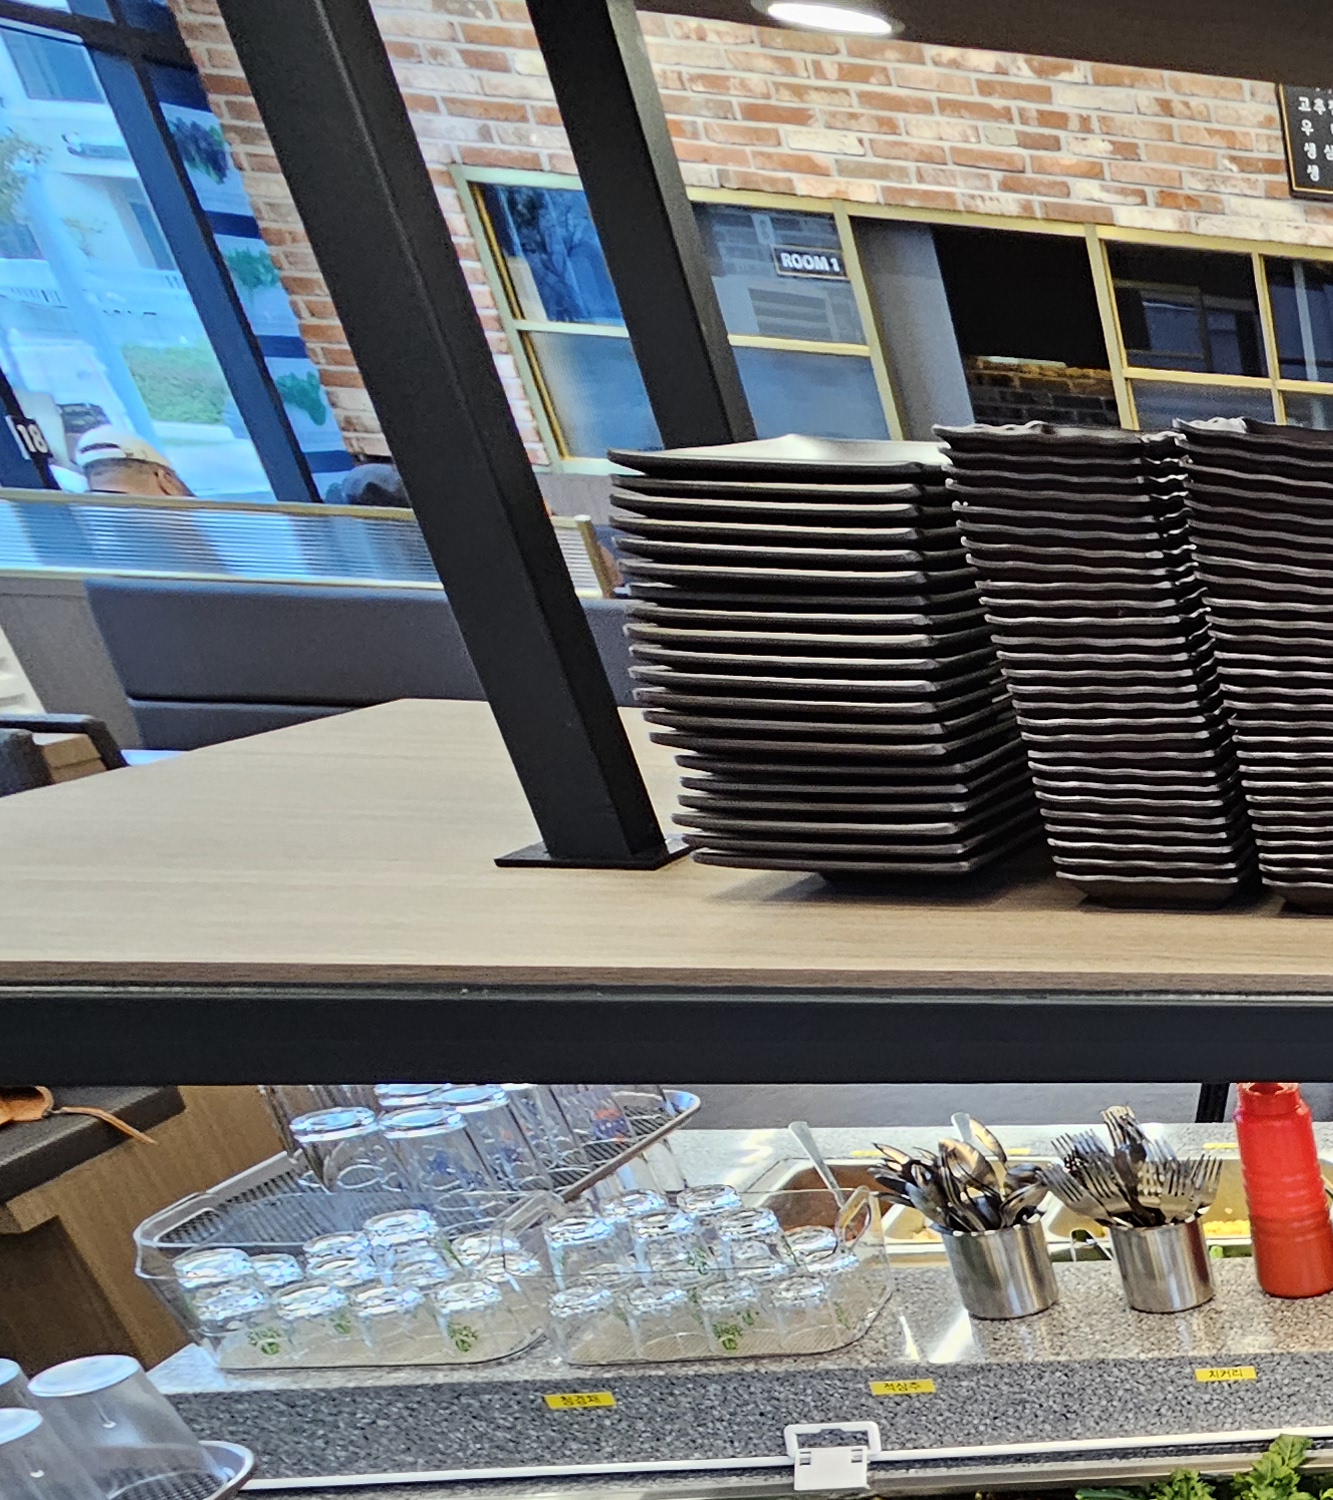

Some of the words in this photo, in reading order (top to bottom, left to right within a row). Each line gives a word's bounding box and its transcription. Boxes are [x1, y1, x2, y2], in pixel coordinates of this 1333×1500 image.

[780, 252, 830, 271] ROOM
[830, 257, 840, 272] 1
[16, 423, 48, 453] 18
